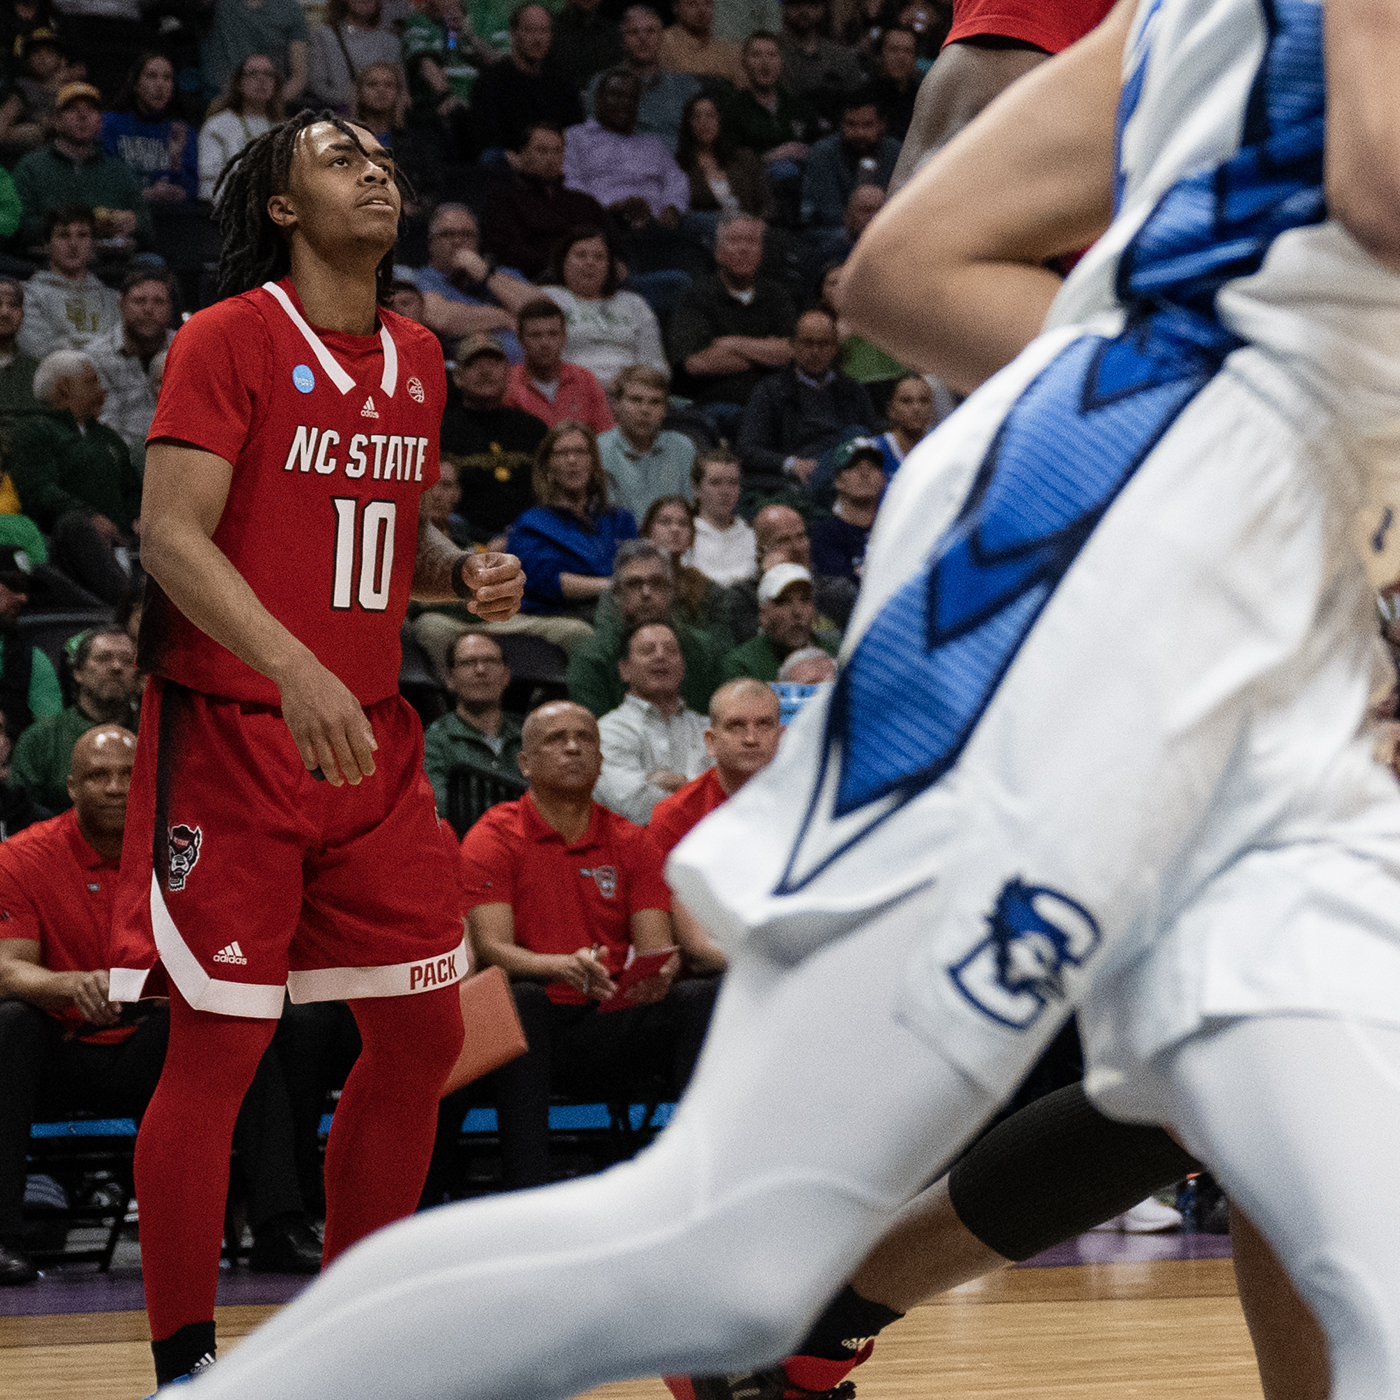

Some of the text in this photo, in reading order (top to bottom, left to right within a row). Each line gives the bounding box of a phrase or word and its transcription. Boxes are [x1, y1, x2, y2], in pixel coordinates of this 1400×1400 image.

[284, 424, 430, 483] NC STATE
[330, 495, 398, 614] 10
[212, 953, 248, 966] adidas
[410, 953, 459, 991] PACK
